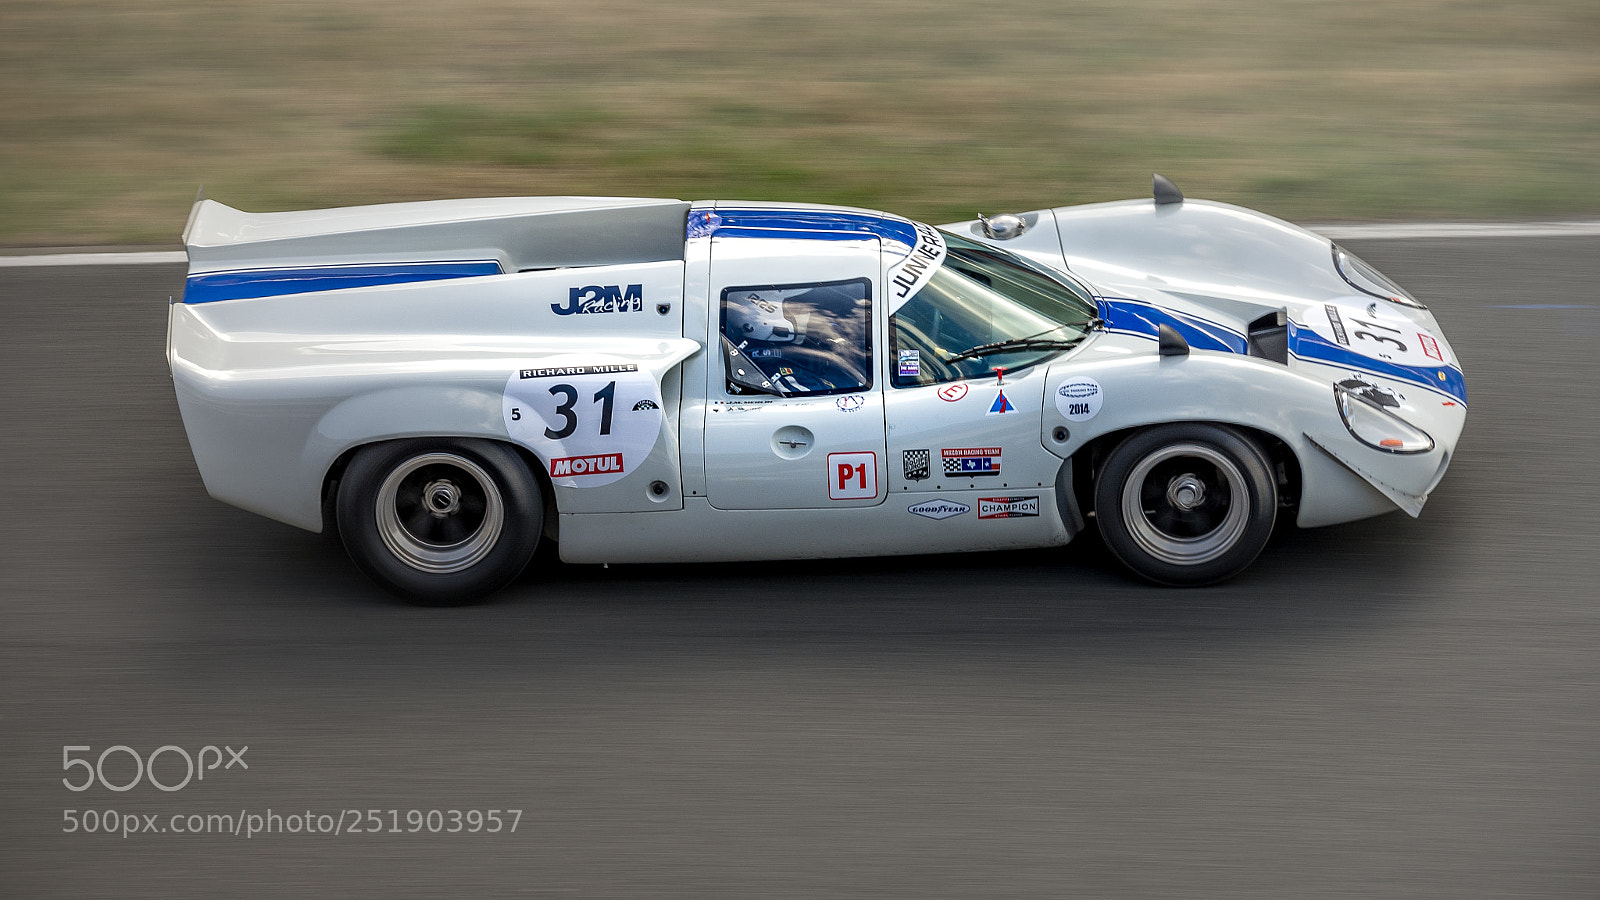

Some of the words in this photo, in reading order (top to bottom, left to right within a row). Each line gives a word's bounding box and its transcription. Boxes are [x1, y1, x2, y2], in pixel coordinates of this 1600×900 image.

[551, 284, 642, 316] J2M
[523, 367, 585, 377] RICHARD
[592, 364, 635, 373] MILLE
[511, 408, 521, 421] 5
[544, 381, 616, 440] 31
[1069, 403, 1090, 415] 2014
[554, 456, 620, 475] MOTUL
[838, 463, 867, 490] P1
[982, 503, 1036, 512] CHAMPION
